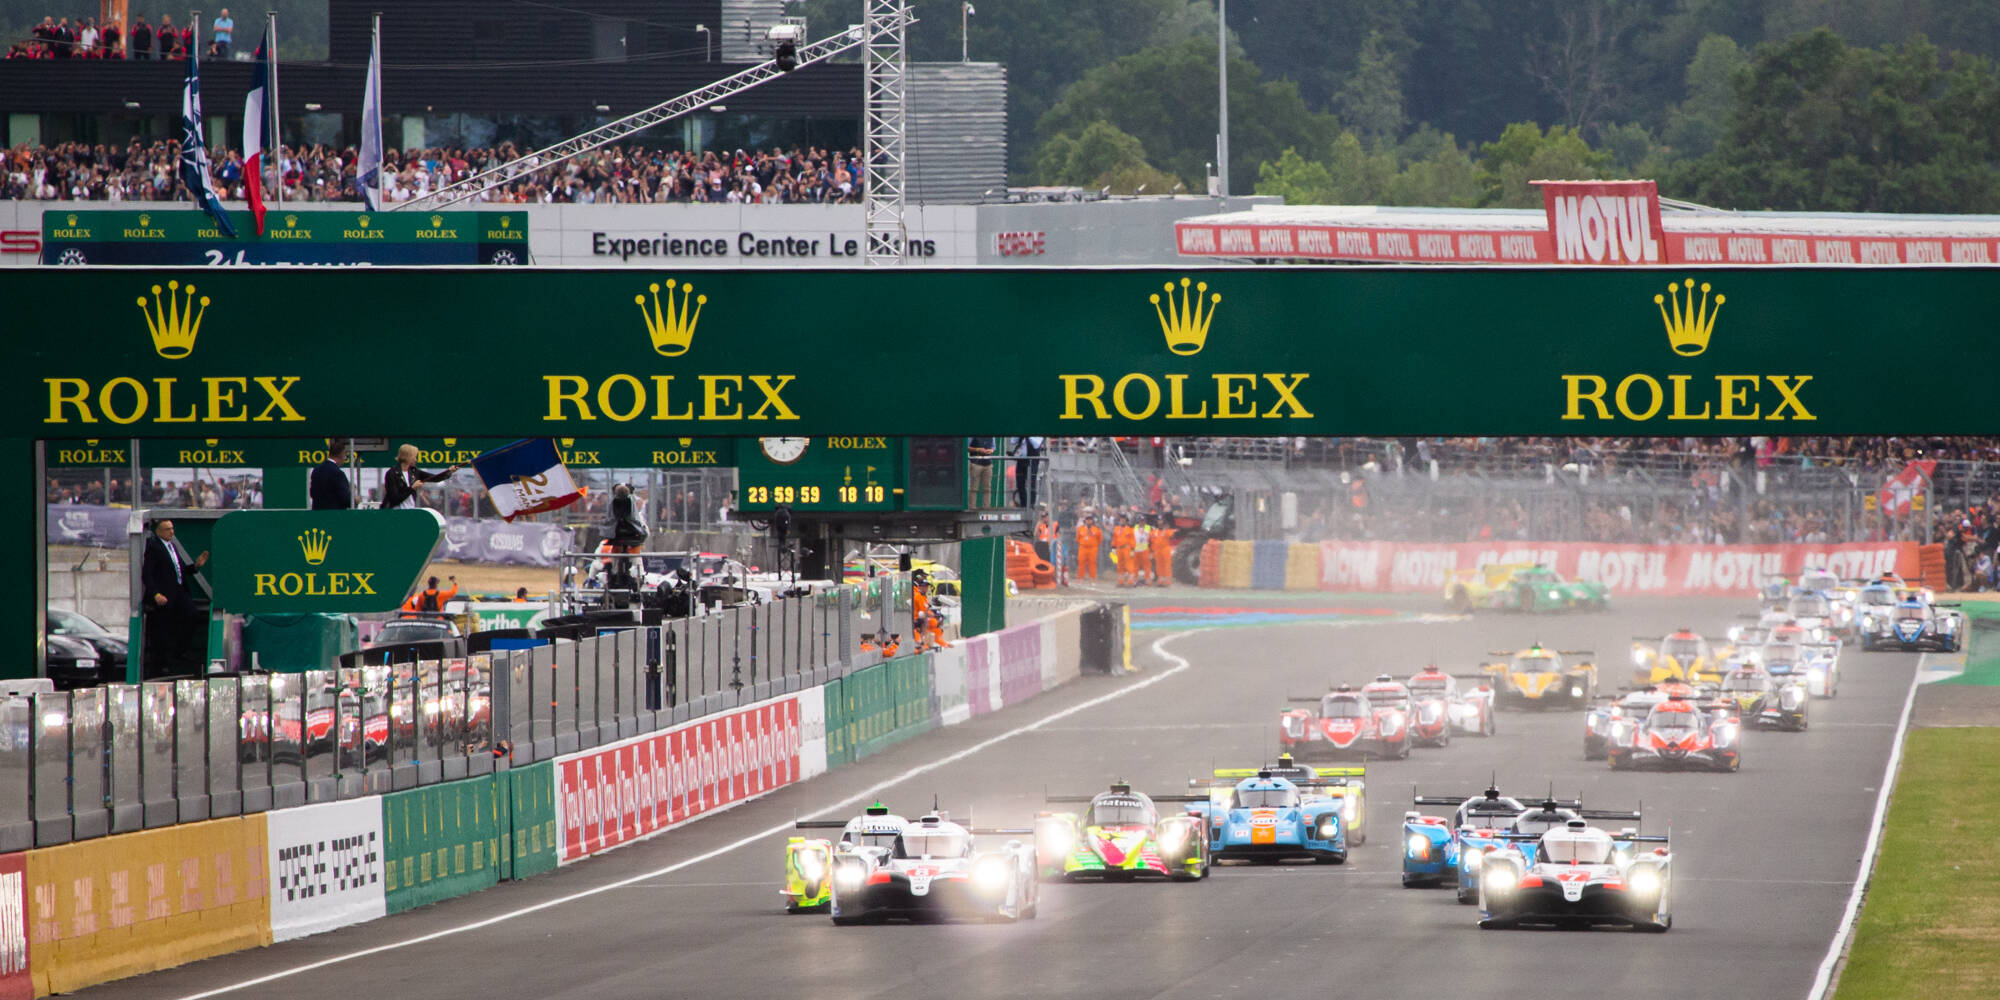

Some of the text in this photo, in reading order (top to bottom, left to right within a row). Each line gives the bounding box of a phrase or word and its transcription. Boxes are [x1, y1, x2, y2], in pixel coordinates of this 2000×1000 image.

[54, 228, 91, 238] ROLEX
[124, 229, 165, 238] ROLEX
[270, 229, 312, 239] ROLEX
[343, 229, 384, 239] ROLEX
[416, 229, 458, 239] ROLEX
[487, 230, 522, 240] ROLEX
[1555, 196, 1658, 261] MOTUL
[593, 232, 935, 262] Experience Center Le Mans
[1182, 229, 1215, 252] MOTUL
[1221, 229, 1254, 252] MOTUL
[1259, 230, 1293, 252] MOTUL
[1298, 230, 1332, 254] MOTUL
[1337, 231, 1371, 255] MOTUL
[1377, 232, 1412, 256] MOTUL
[1418, 233, 1454, 257] MOTUL
[1459, 234, 1496, 258] MOTUL
[1501, 235, 1536, 259] MOTUL
[1684, 237, 1722, 261] MOTUL
[1728, 238, 1766, 262] MOTUL
[1772, 239, 1810, 263] MOTUL
[1815, 240, 1856, 263] MOTUL
[1860, 241, 1900, 263] MOTUL
[1906, 242, 1946, 263] MOTUL
[1951, 242, 1991, 263] MOTUL
[44, 376, 306, 425] ROLEX
[543, 374, 800, 422] ROLEX
[1059, 372, 1314, 421] ROLEX
[1562, 373, 1816, 422] ROLEX
[828, 436, 887, 449] ROLEX
[59, 450, 125, 463] ROLEX
[179, 450, 245, 464] ROLEX
[650, 450, 717, 464] ROLEX
[839, 486, 884, 503] 18 18
[254, 572, 377, 596] ROLEX
